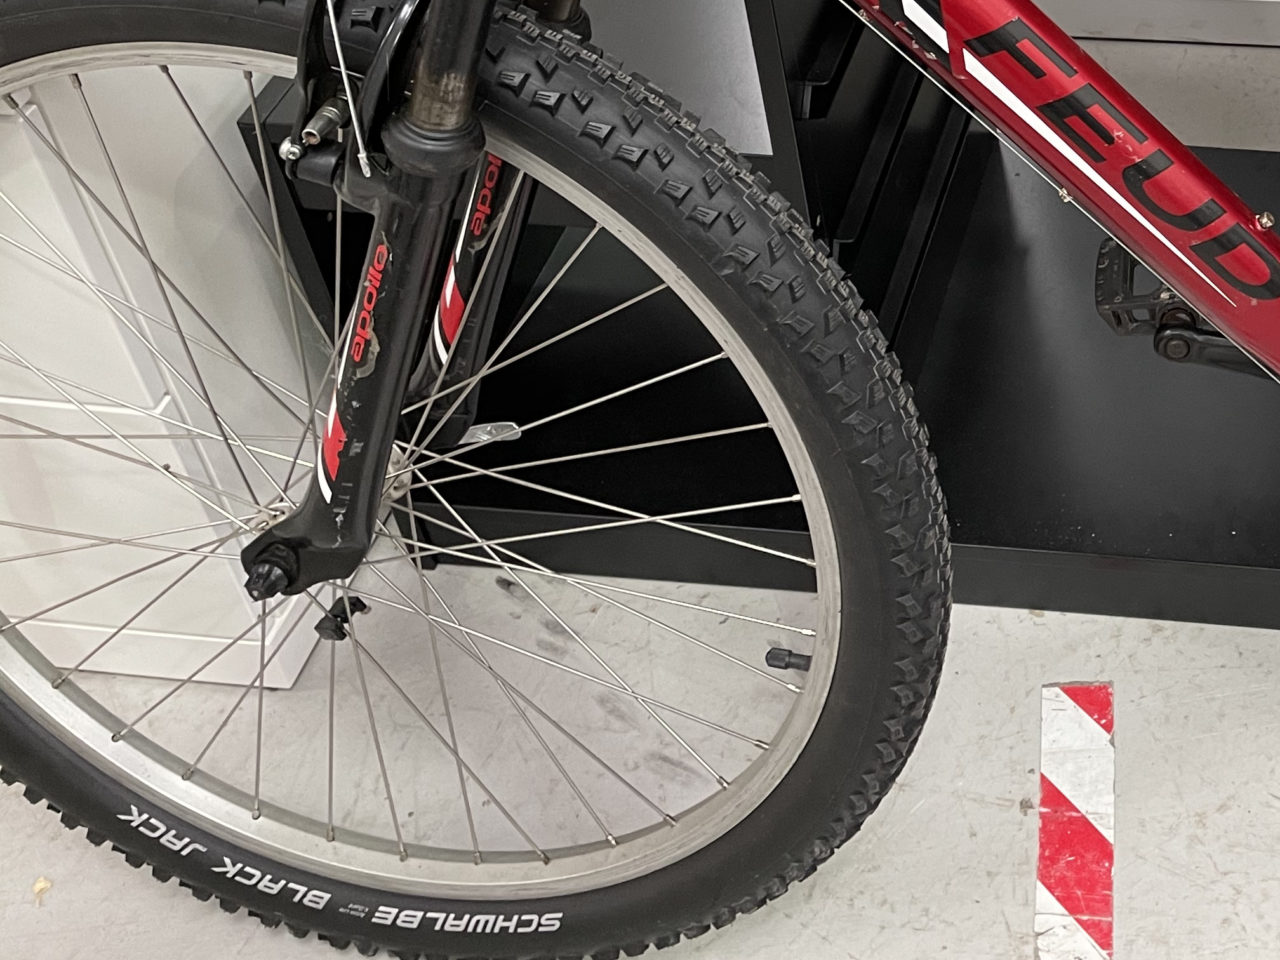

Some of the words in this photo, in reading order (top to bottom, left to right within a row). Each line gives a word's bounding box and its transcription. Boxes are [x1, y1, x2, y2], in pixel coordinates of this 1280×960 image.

[470, 150, 502, 237] apol
[351, 243, 388, 363] apollo
[116, 804, 208, 855] JACK
[211, 855, 332, 911] BLACK
[371, 905, 564, 934] SCHWALBE
